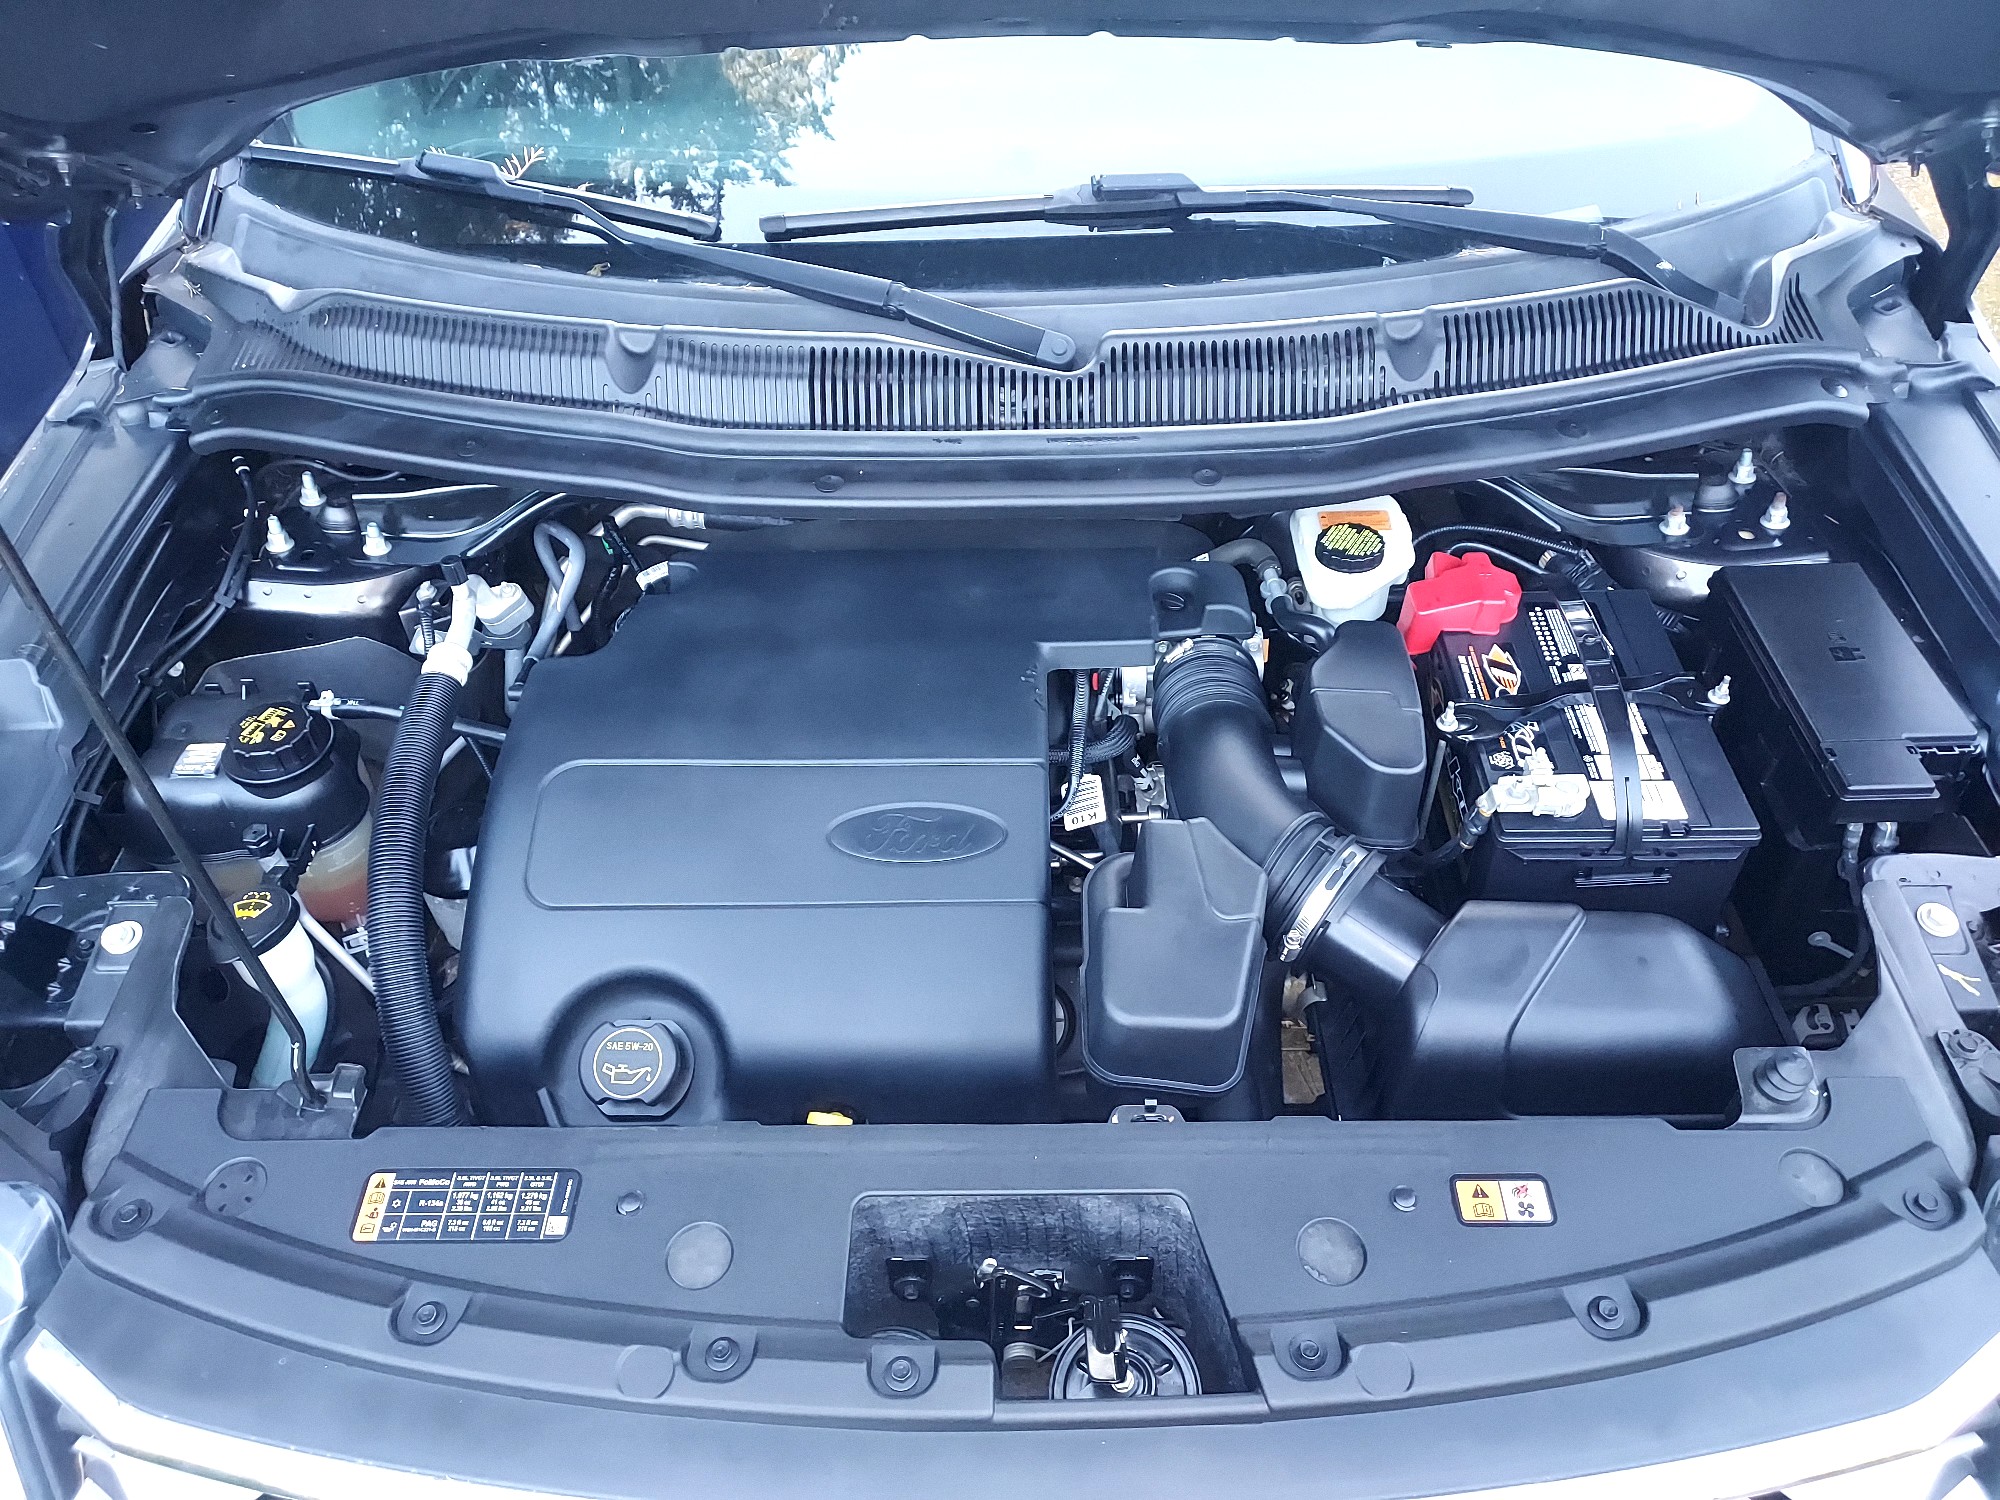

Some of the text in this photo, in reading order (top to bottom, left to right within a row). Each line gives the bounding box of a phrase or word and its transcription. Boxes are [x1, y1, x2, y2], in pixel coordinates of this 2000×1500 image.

[860, 813, 976, 855] Ford
[606, 1041, 654, 1052] SAE 5W-20
[418, 1178, 451, 1186] FoMoCo
[418, 1199, 444, 1207] R-134a
[421, 1219, 438, 1227] PAG
